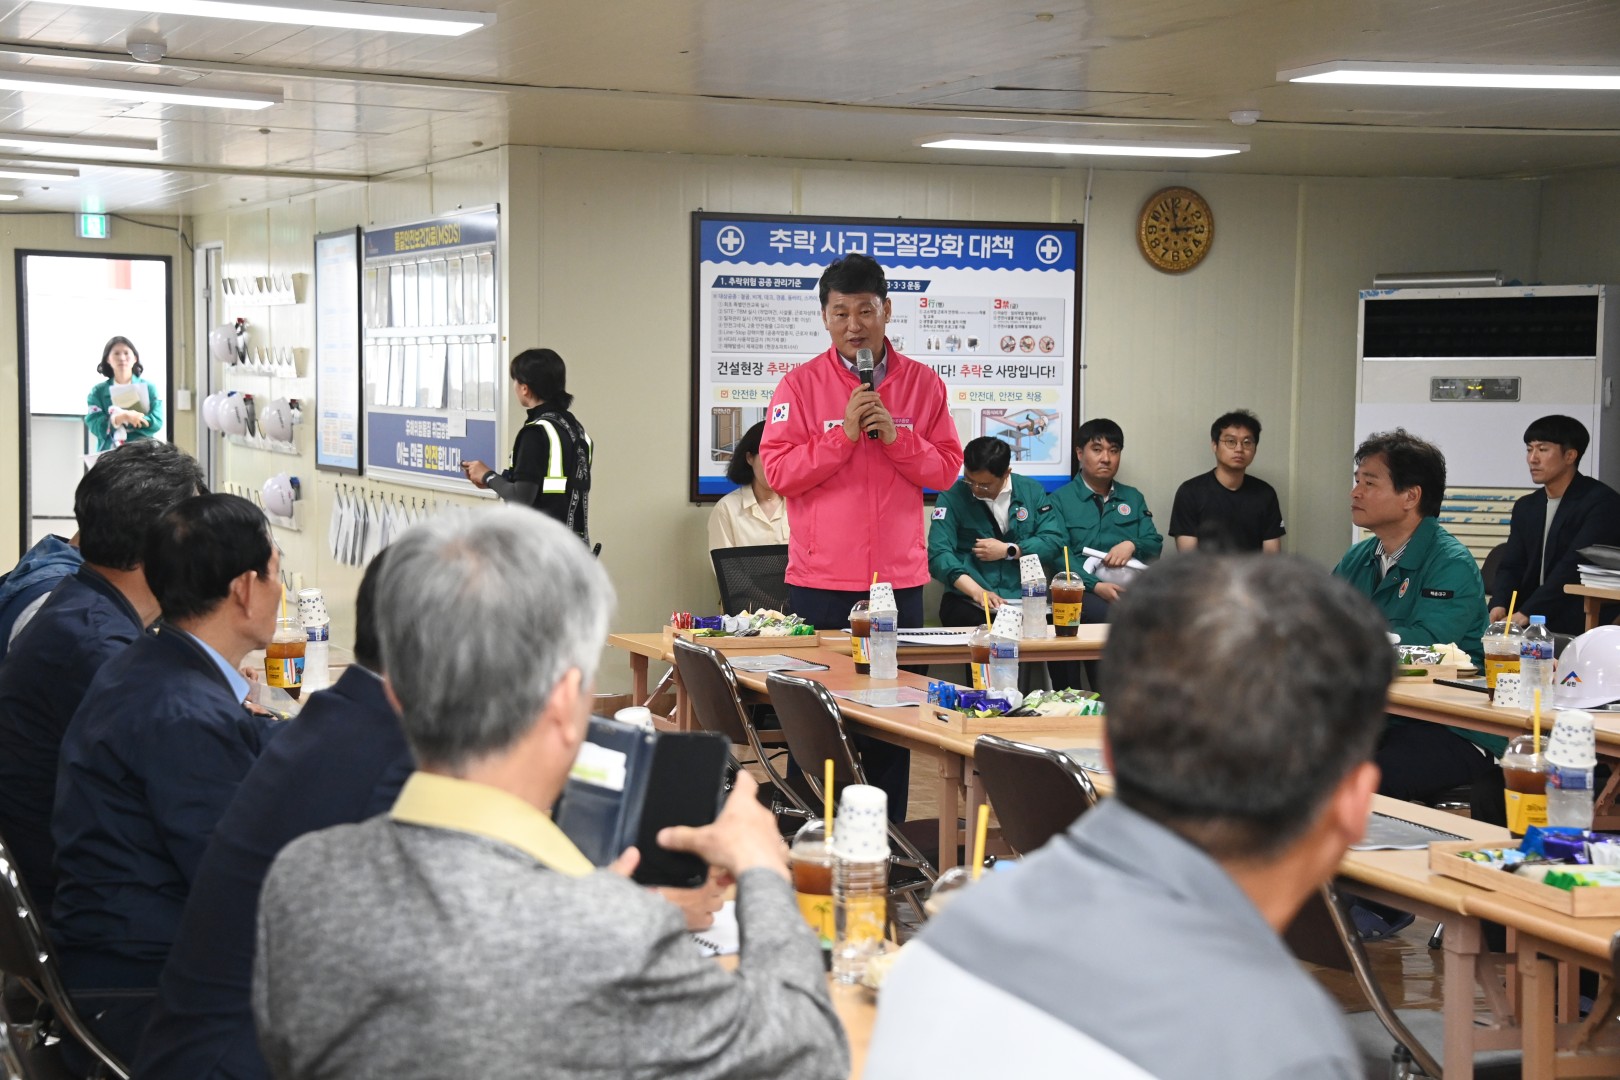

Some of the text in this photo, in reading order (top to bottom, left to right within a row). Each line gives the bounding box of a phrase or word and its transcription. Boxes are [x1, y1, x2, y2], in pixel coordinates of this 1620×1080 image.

[1159, 200, 1169, 212] 11
[1185, 202, 1191, 211] 1
[1151, 210, 1161, 222] 10
[1191, 210, 1201, 221] 2
[1148, 225, 1157, 234] 9
[1194, 225, 1204, 234] 3
[769, 229, 1014, 259] 추락 사고 근절강화 대책
[1150, 238, 1160, 248] 8
[1192, 239, 1202, 248] 4
[1161, 247, 1168, 257] 7
[1172, 251, 1179, 261] 6
[1183, 247, 1193, 258] 5
[720, 277, 802, 288] 1. 추락위험 공종 관리기준
[907, 281, 921, 291] 운동
[717, 361, 764, 376] 건설현장
[960, 364, 993, 378] 추락은
[996, 365, 1056, 379] 사망입니다!
[732, 389, 757, 400] 안전한
[969, 391, 1042, 403] 안전대, 안전모 착용
[396, 441, 461, 473] 아는 만큼 안전합니다!
